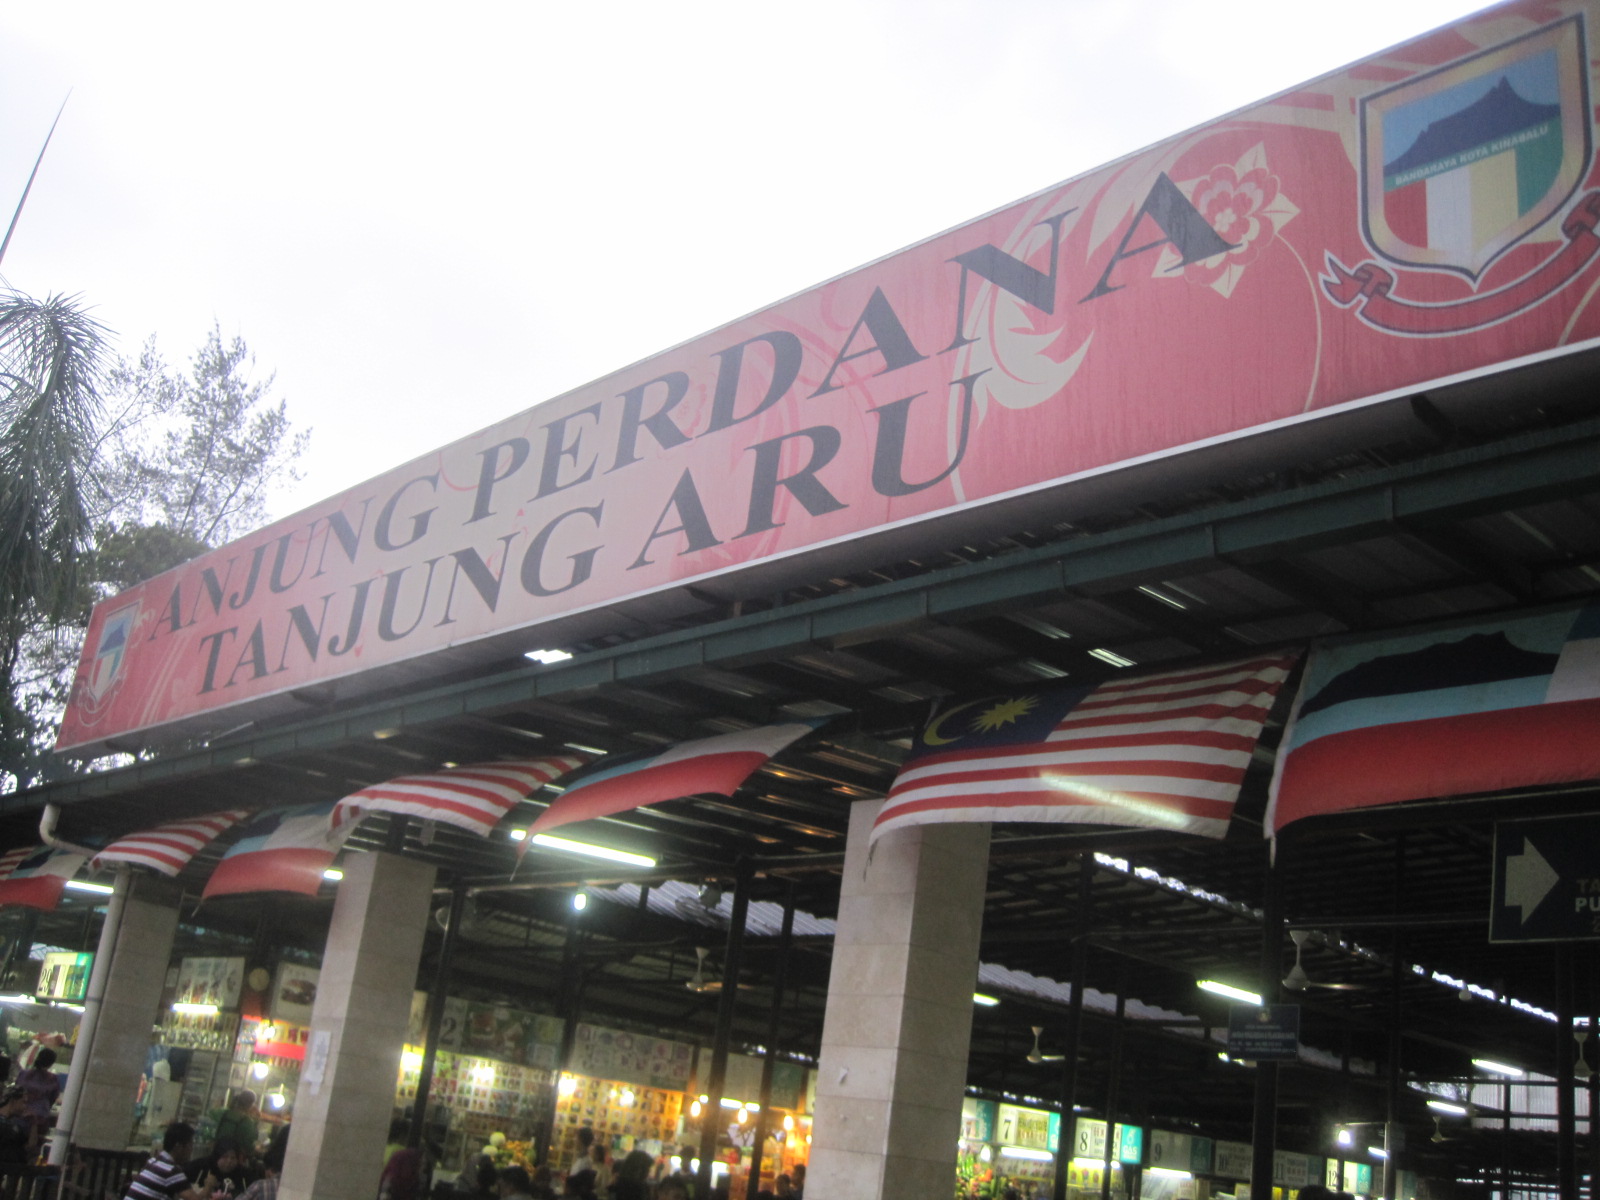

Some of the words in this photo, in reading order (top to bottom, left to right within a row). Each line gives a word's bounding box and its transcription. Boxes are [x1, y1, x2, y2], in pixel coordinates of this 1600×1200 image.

[1395, 158, 1457, 185] BANDARAYA
[1460, 148, 1488, 163] KOTA
[1491, 125, 1549, 153] KINABALU
[147, 467, 442, 641] ANJUNG
[462, 171, 1242, 526] PERDANA
[197, 499, 605, 695] TANJUNG
[626, 367, 992, 571] ARU
[440, 1016, 457, 1044] 2
[1003, 1119, 1011, 1140] 7
[1080, 1131, 1088, 1152] 8
